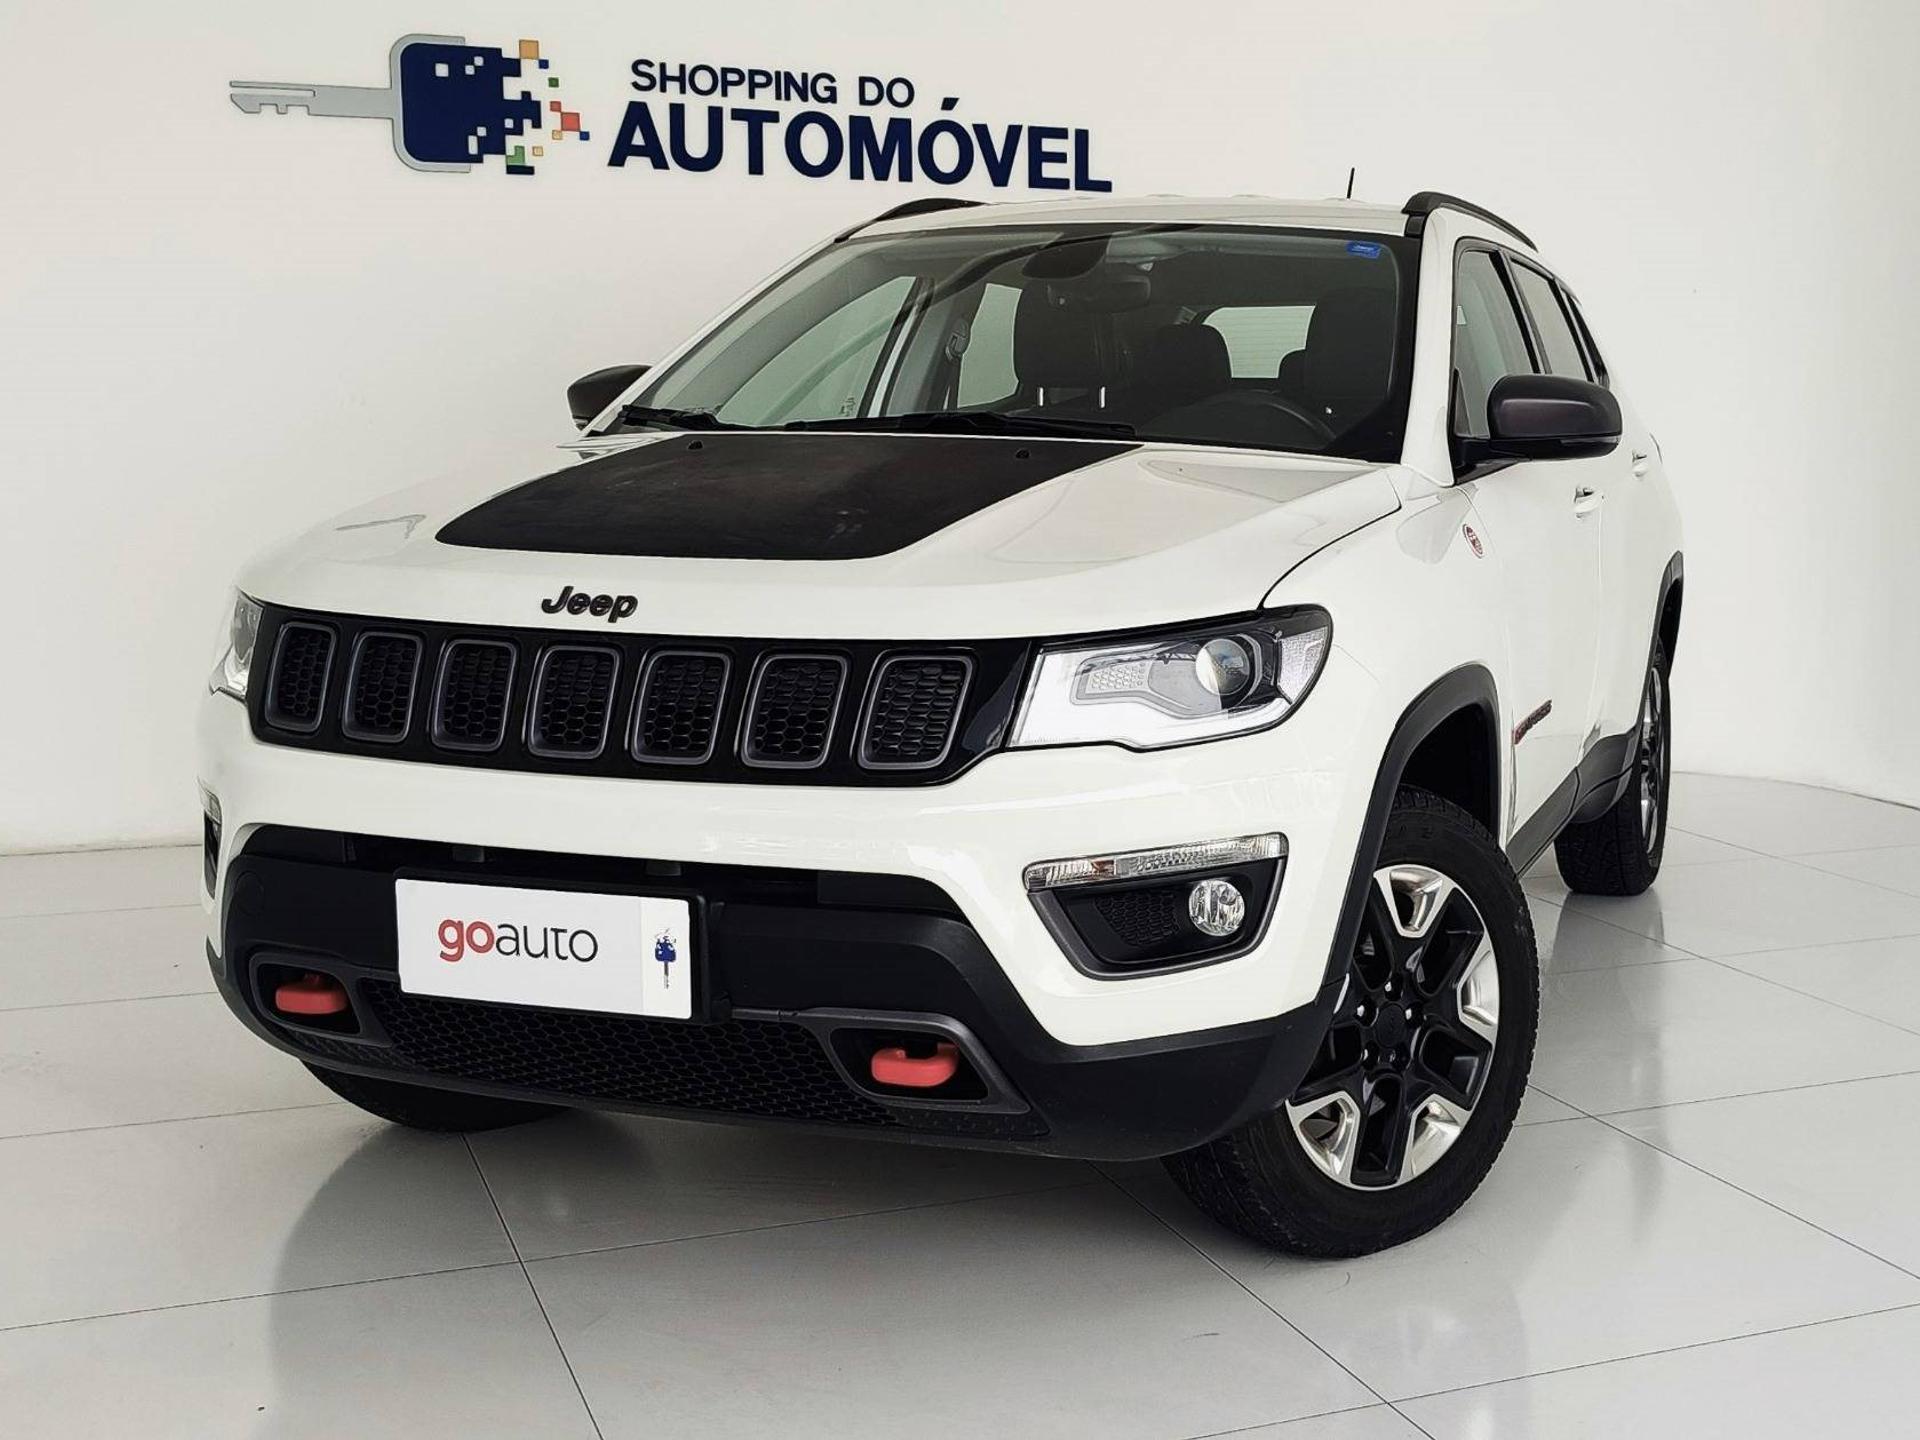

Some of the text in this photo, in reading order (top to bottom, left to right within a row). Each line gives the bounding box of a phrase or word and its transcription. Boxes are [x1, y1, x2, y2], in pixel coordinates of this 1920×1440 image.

[630, 58, 916, 109] SHOPPING DO
[607, 96, 1113, 193] AUTOMÓVEL
[541, 585, 638, 623] Jeep
[437, 918, 599, 963] goauto
